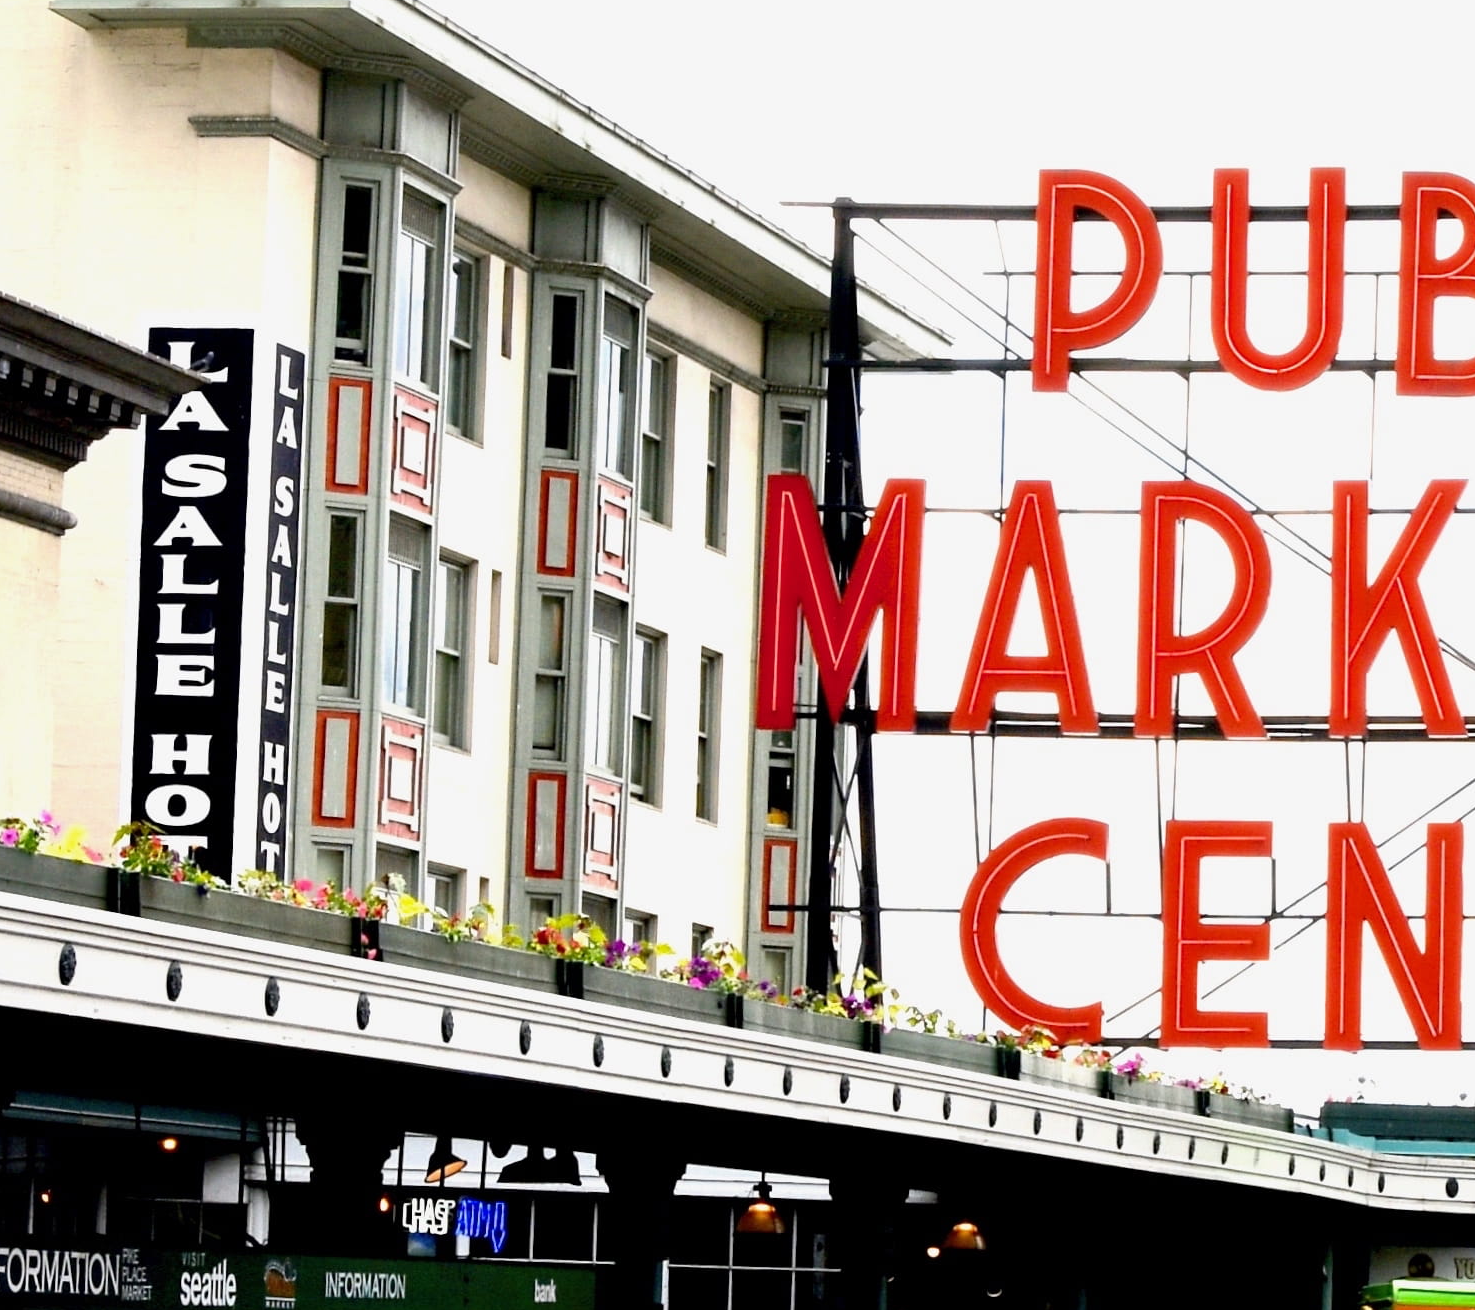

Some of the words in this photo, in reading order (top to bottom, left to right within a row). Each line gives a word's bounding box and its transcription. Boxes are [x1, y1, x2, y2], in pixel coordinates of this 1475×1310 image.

[158, 341, 229, 432] LA
[275, 354, 299, 450] LA
[153, 454, 228, 697] SALLE
[264, 476, 295, 714] SALLE
[122, 1248, 141, 1266] PIKE
[181, 1251, 207, 1268] VISIT
[122, 1265, 148, 1284] PLACE
[180, 1258, 237, 1308] seattle
[325, 1271, 406, 1300] INFORMATION
[122, 1284, 153, 1302] MARKET
[534, 1278, 557, 1304] bank
